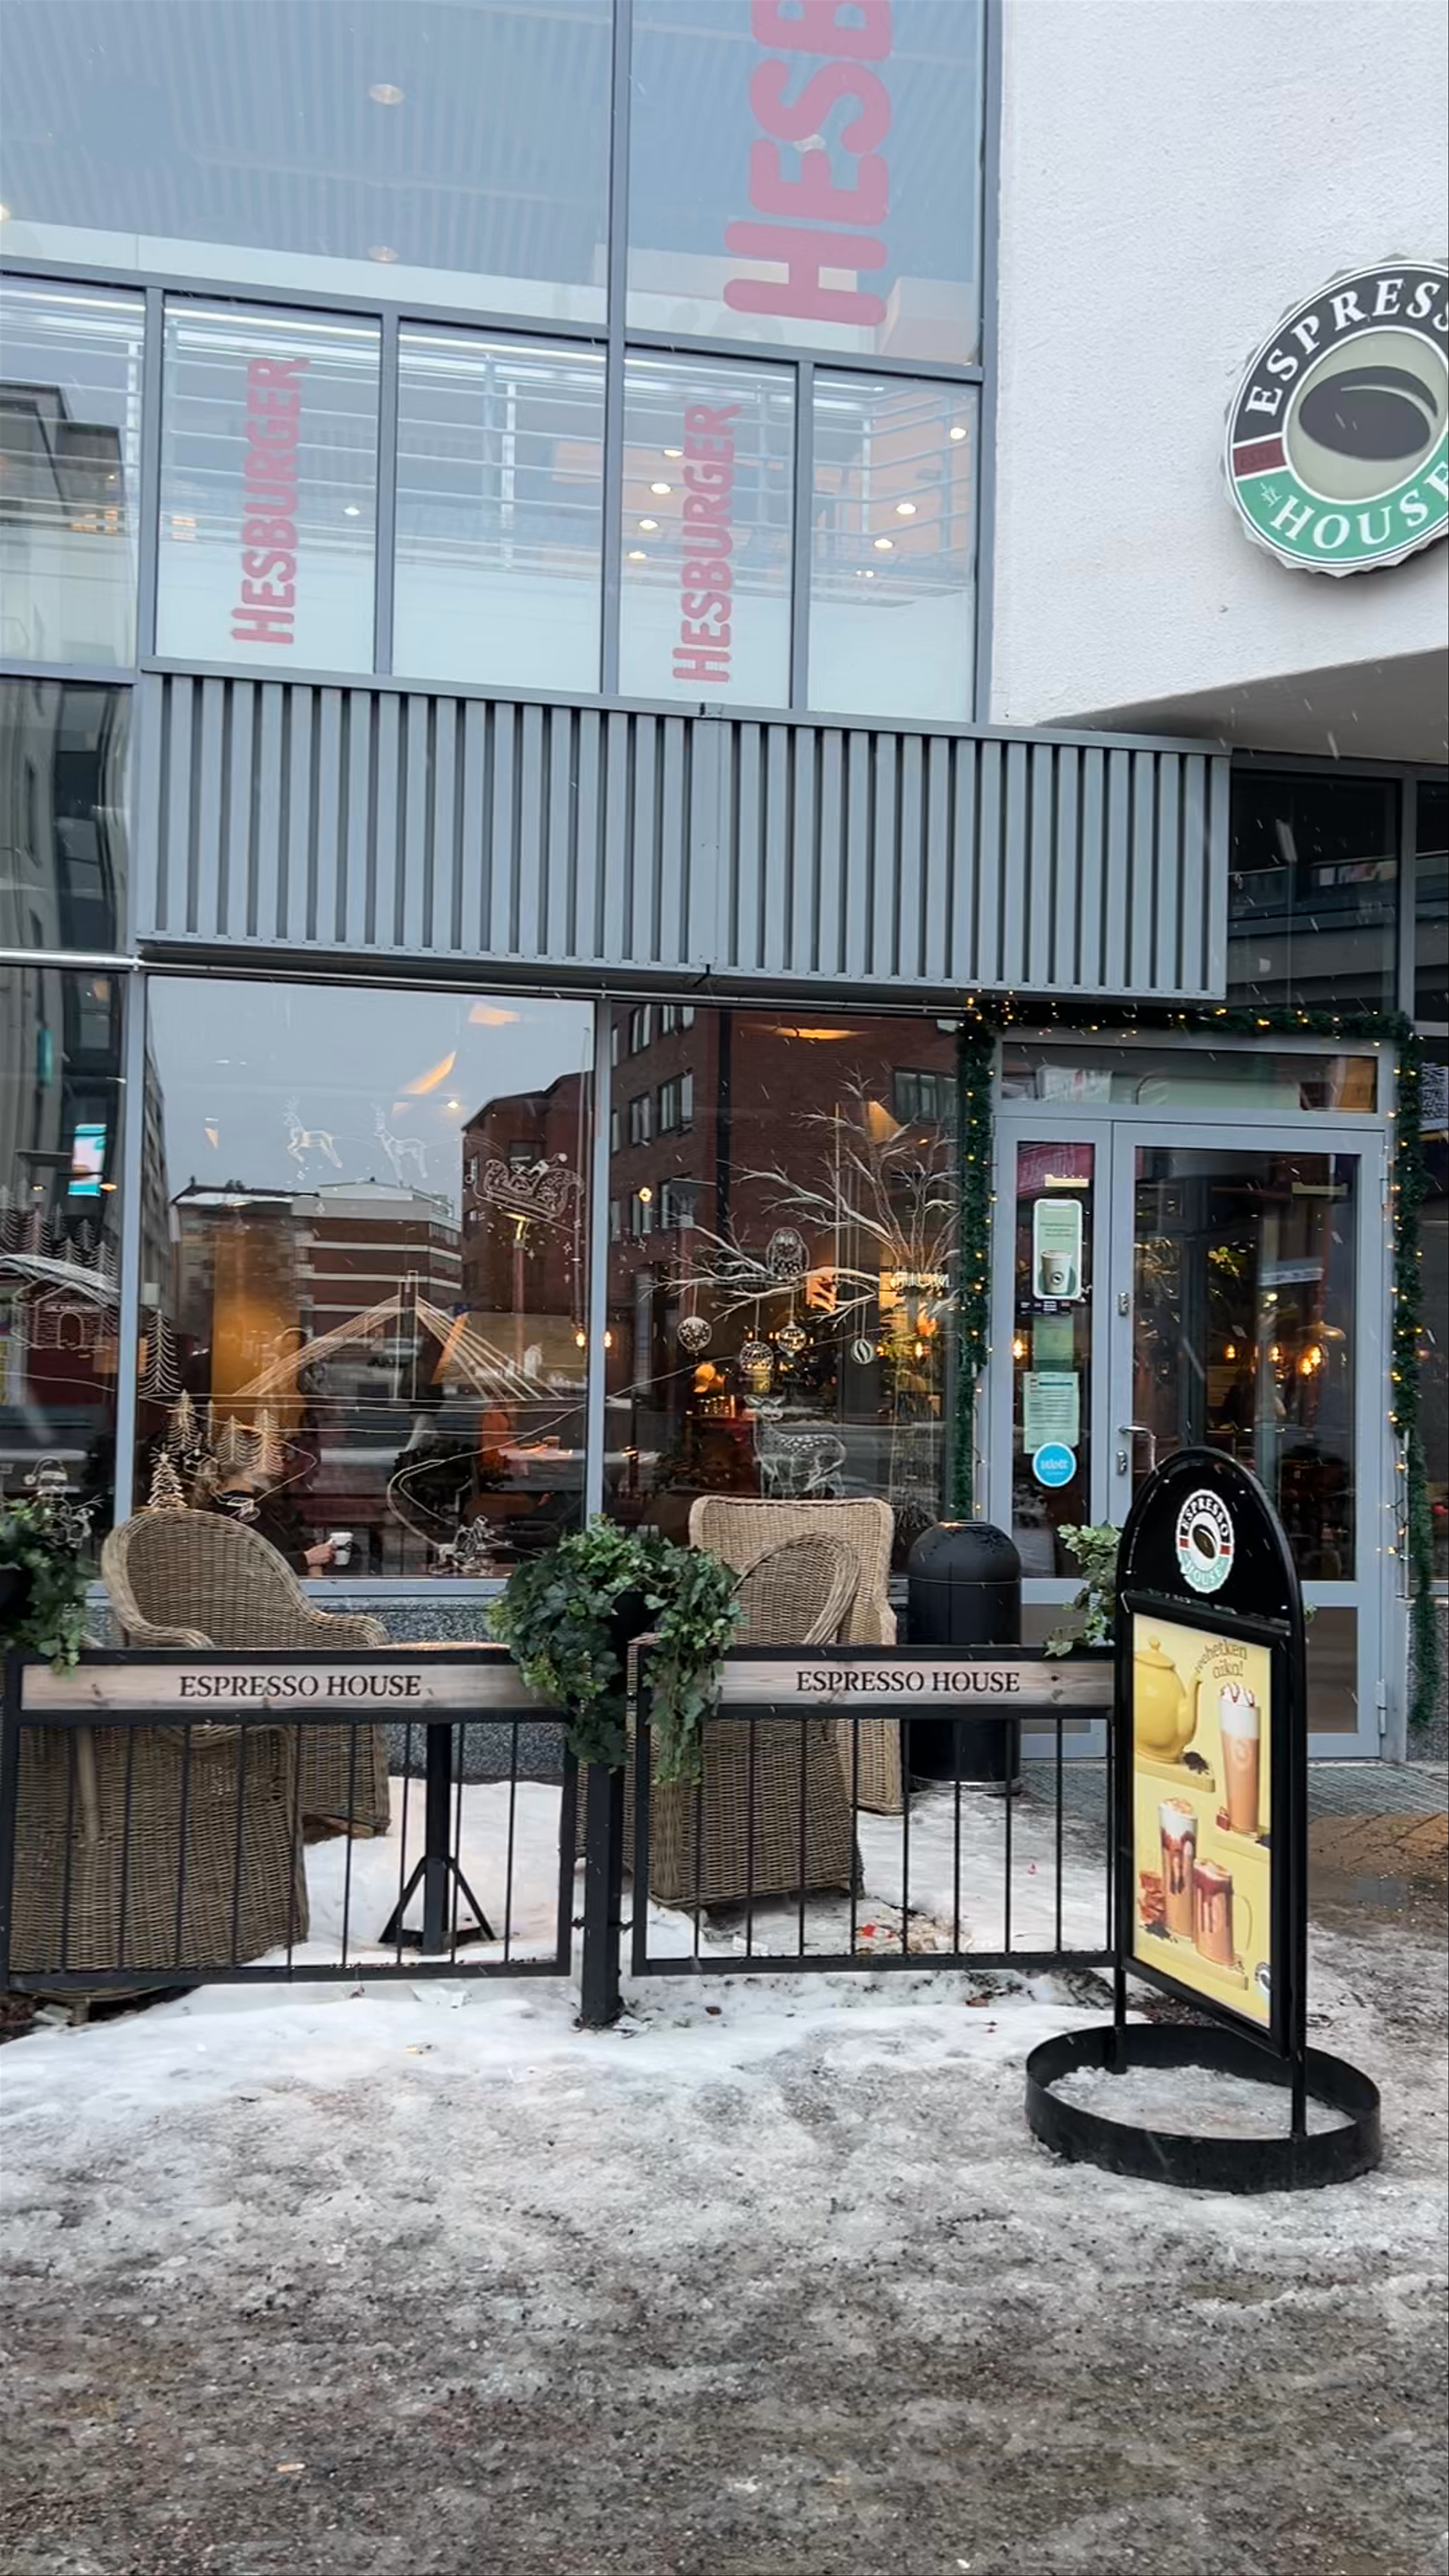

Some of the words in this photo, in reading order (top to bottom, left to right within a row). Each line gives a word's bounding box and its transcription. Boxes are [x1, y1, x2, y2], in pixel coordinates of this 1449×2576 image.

[723, 0, 892, 327] HESB
[230, 357, 311, 644] HESBURGER
[672, 404, 741, 681] HESBURGER
[1181, 1498, 1228, 1536] ESPRESSO
[180, 1675, 318, 1697] ESPRESSO
[327, 1675, 421, 1696] HOUSE
[797, 1671, 924, 1692] ESPRESSO
[932, 1672, 1020, 1692] HOUSE
